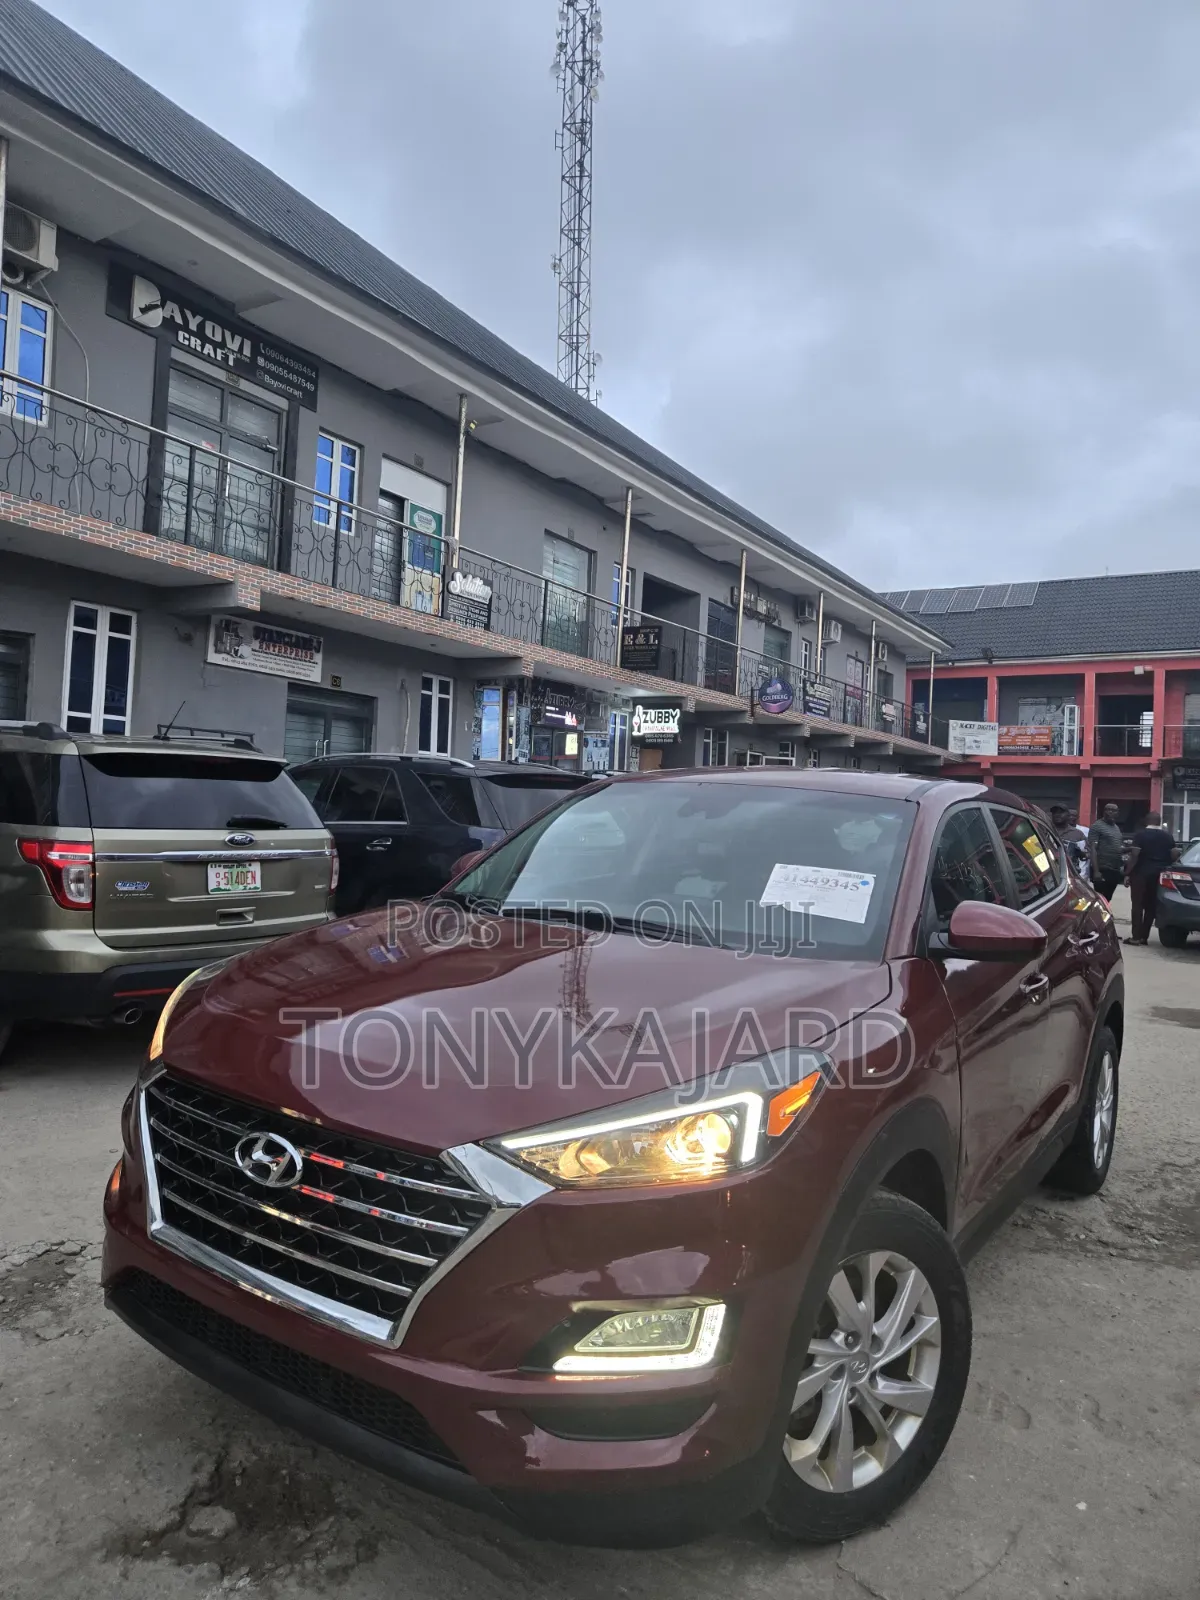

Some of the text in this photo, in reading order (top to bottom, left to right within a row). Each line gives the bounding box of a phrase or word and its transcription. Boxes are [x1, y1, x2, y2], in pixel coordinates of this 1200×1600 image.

[177, 330, 236, 367] CRAFT
[648, 633, 659, 645] L
[258, 640, 315, 661] ENTERPRISE
[642, 710, 679, 724] ZUBBY
